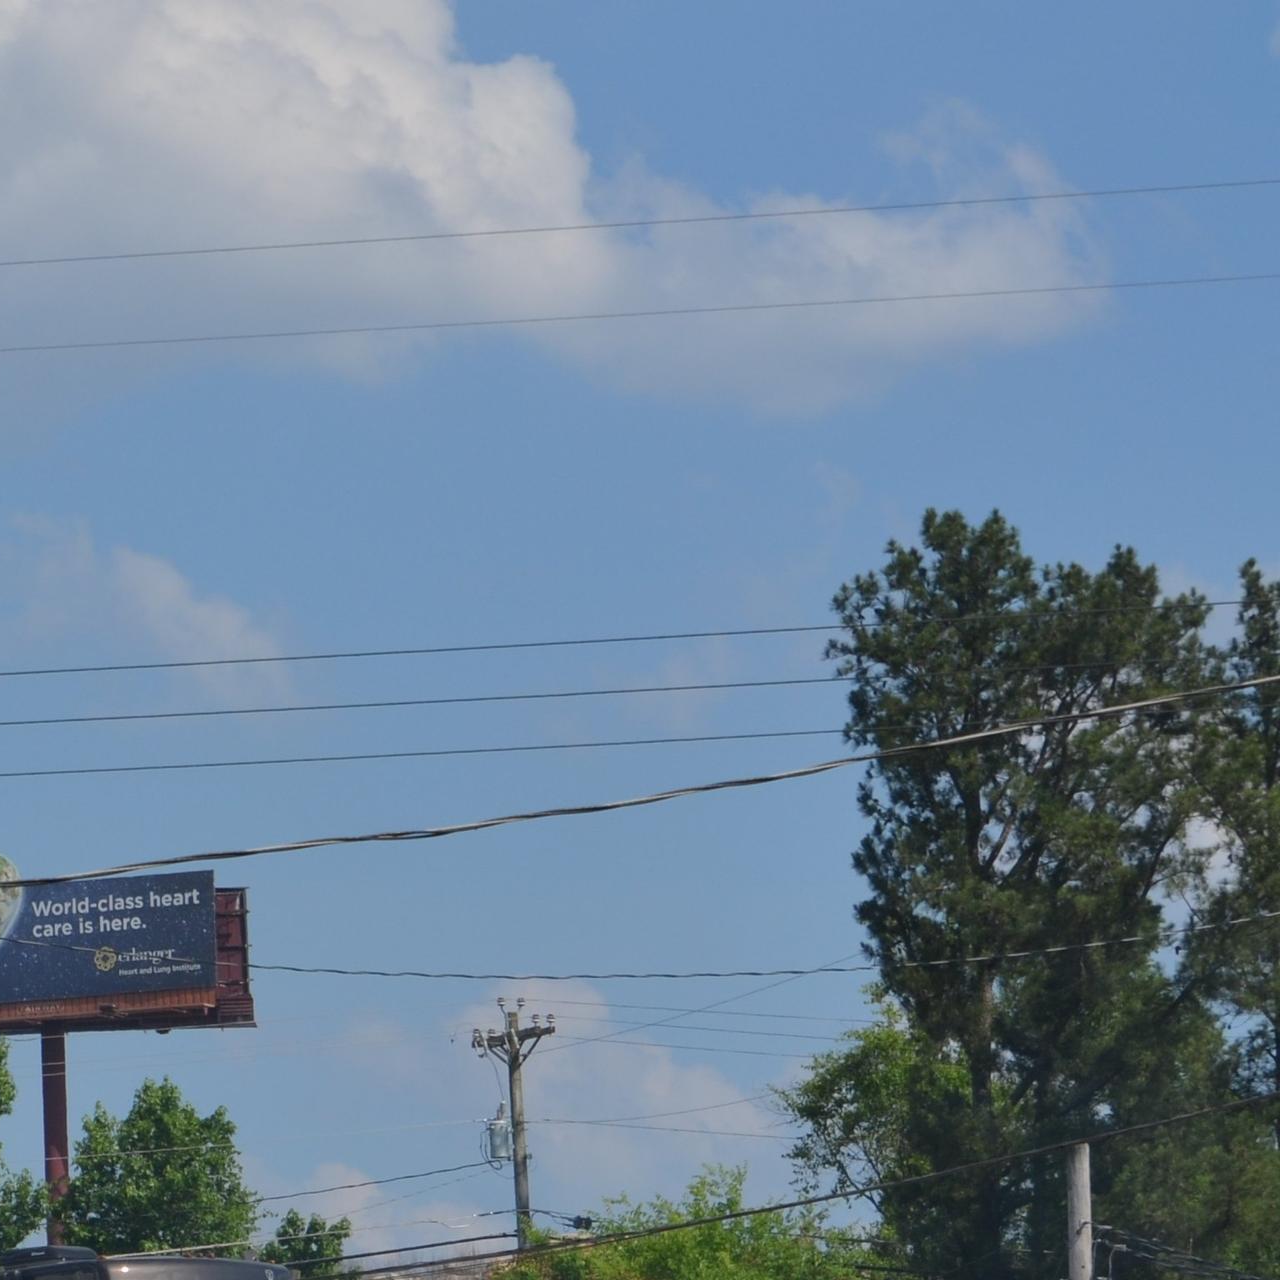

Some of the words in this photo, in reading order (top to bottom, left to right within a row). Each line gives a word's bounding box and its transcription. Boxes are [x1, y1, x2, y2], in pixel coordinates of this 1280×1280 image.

[32, 893, 144, 918] World-class
[149, 888, 200, 909] heart
[32, 921, 73, 938] care
[79, 918, 94, 935] is
[99, 914, 147, 933] here.
[119, 967, 138, 976] Heart
[139, 966, 152, 974] and
[153, 965, 171, 975] Lung
